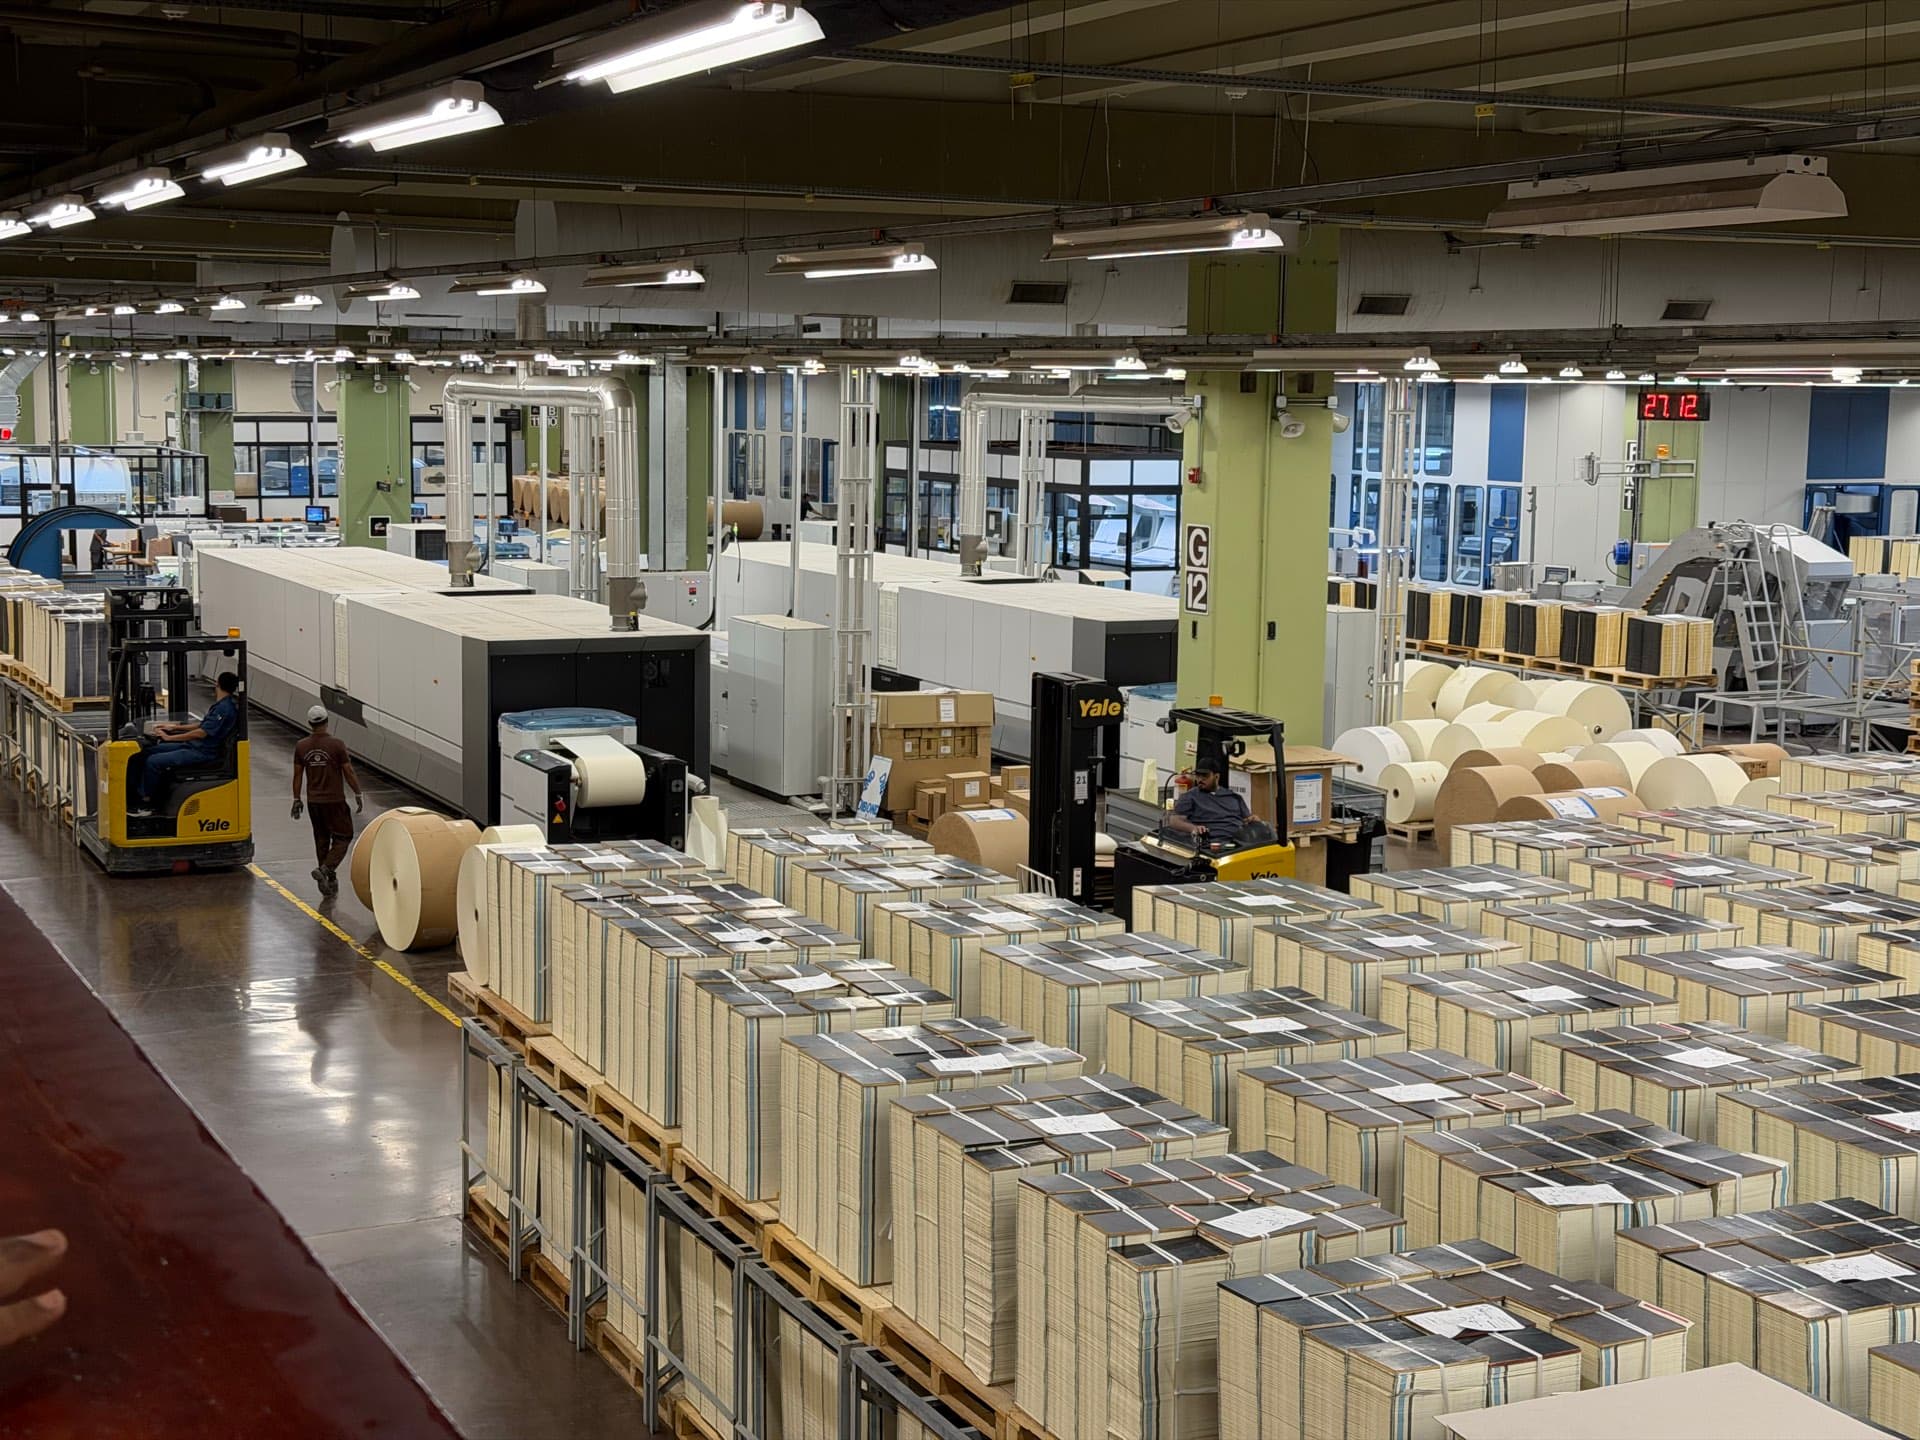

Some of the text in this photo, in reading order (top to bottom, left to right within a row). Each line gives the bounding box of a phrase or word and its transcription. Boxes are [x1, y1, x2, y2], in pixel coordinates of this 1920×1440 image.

[1188, 527, 1208, 567] G
[1187, 573, 1207, 610] 12
[1079, 698, 1121, 717] Yale
[197, 818, 230, 832] Yale
